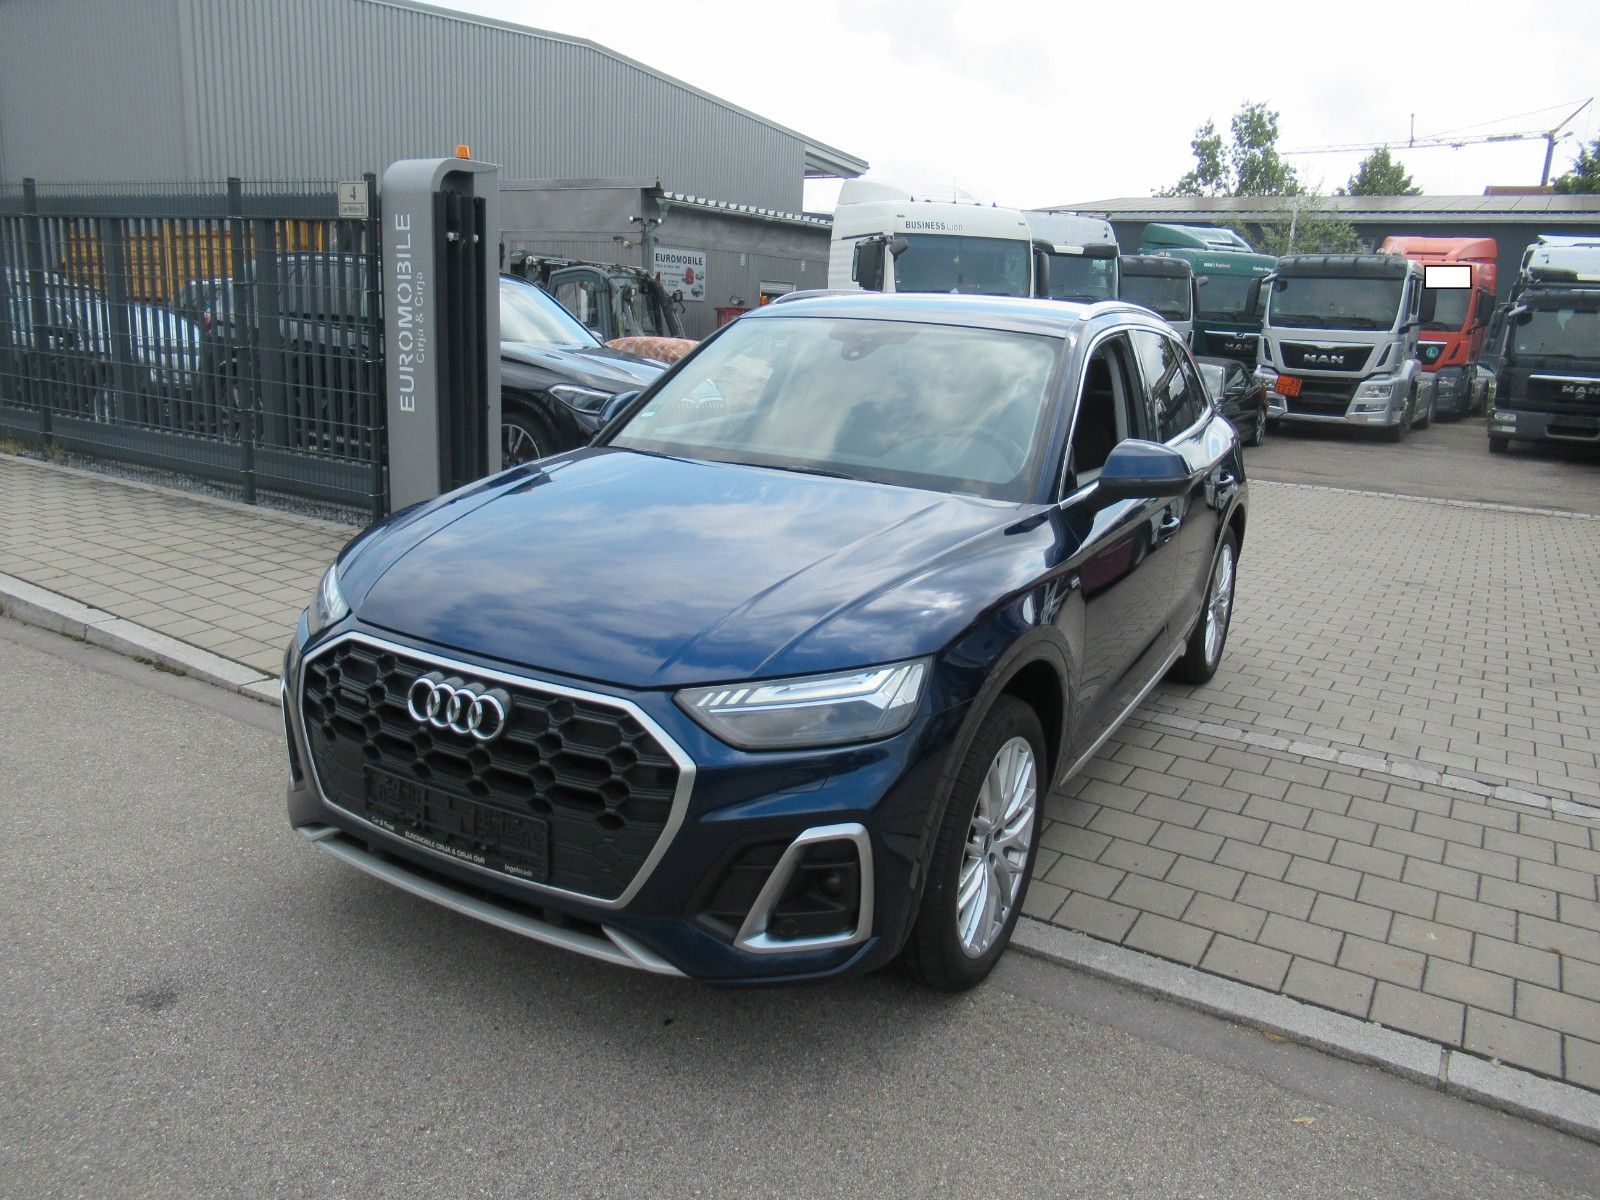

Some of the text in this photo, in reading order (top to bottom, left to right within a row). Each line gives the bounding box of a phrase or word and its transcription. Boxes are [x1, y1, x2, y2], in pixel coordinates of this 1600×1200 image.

[350, 186, 357, 201] 4
[905, 220, 964, 232] BUSINESS Lion
[655, 252, 704, 266] EUROMOBILE
[395, 213, 415, 412] EUROMOBILE
[414, 271, 427, 363] Cirja & Cirja
[1225, 342, 1254, 351] MAN
[1303, 353, 1344, 364] MAN
[1561, 385, 1600, 395] MAN
[405, 831, 436, 847] EUROMOBILE
